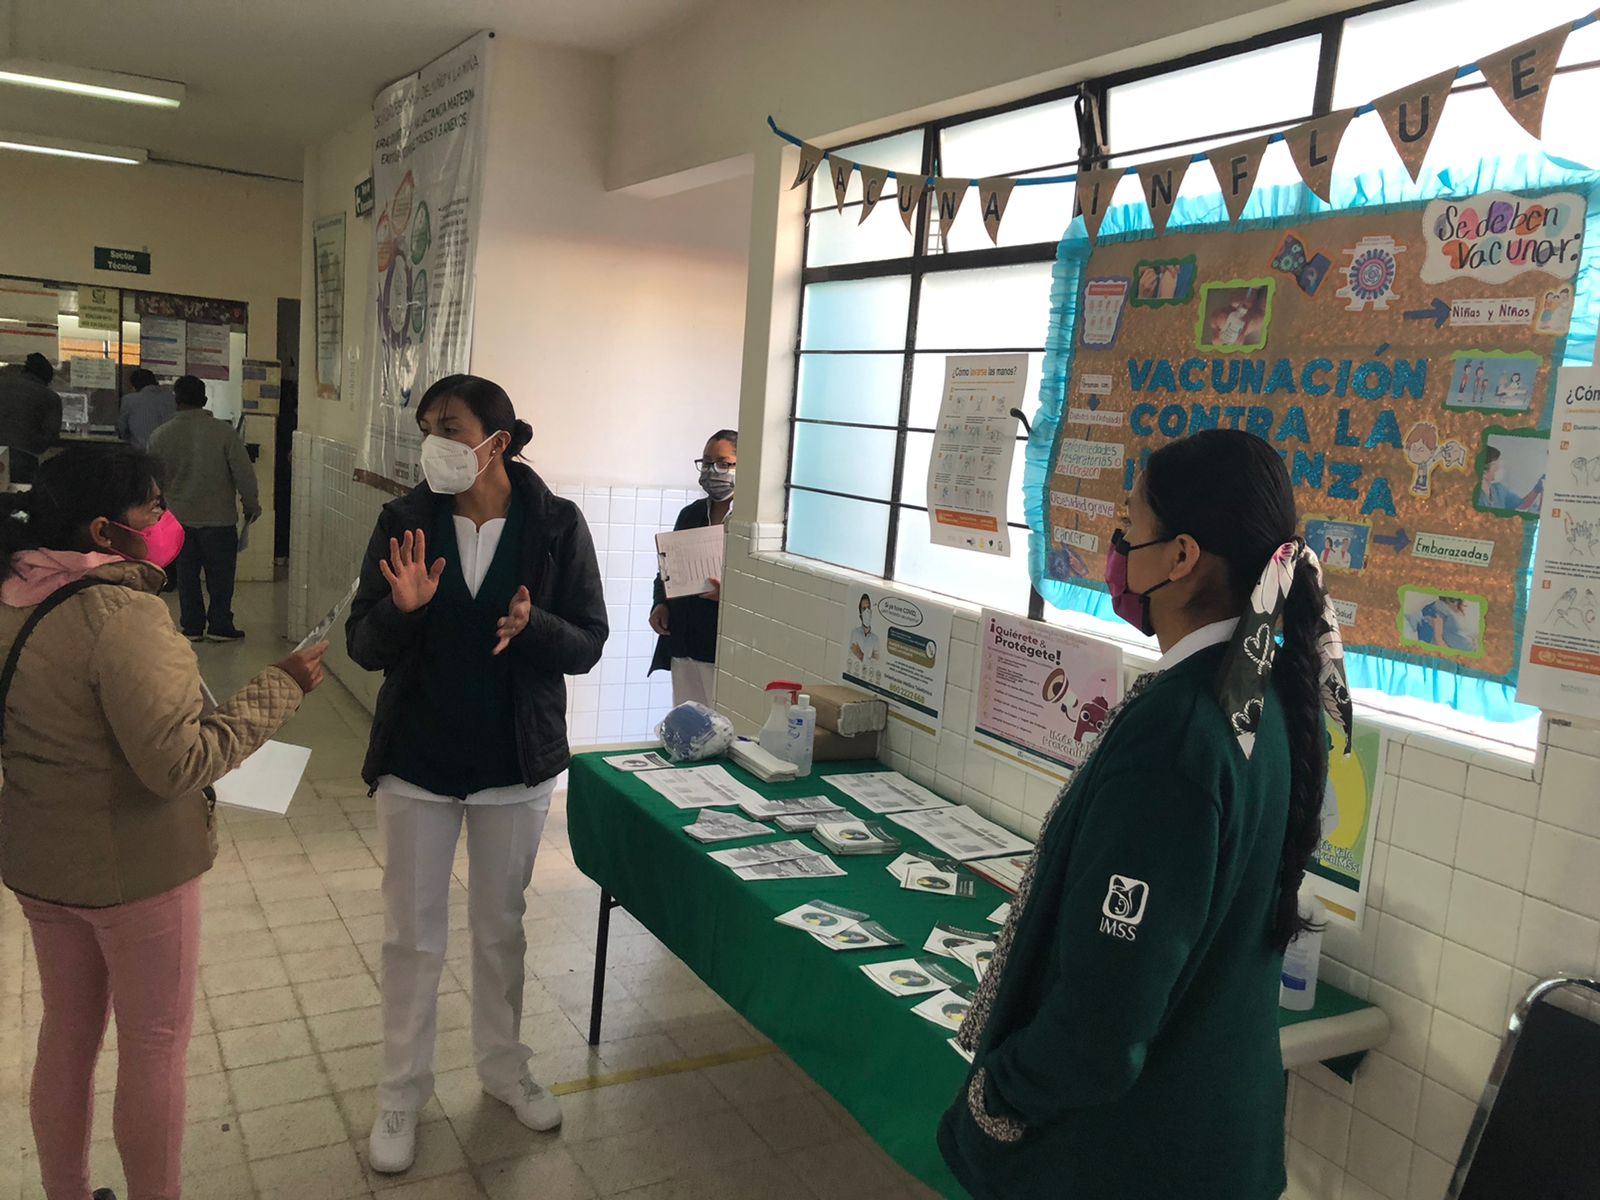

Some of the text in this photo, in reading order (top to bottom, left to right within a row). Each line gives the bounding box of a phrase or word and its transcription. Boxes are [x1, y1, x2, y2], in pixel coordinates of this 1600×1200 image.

[800, 160, 1001, 221] VACUNA
[1438, 200, 1559, 242] Se deben
[107, 260, 137, 272] Técnico
[110, 250, 135, 260] Sector
[1452, 303, 1530, 320] Niñas y Niños
[1127, 342, 1428, 400] VACUNACIÓN
[1129, 403, 1404, 449] CONTRA LA
[1415, 537, 1489, 562] Embarazadas
[990, 618, 1039, 646] ¡Quiérete
[1039, 639, 1047, 649] &
[995, 635, 1062, 666] Protégete!
[1099, 916, 1137, 941] IMSS
